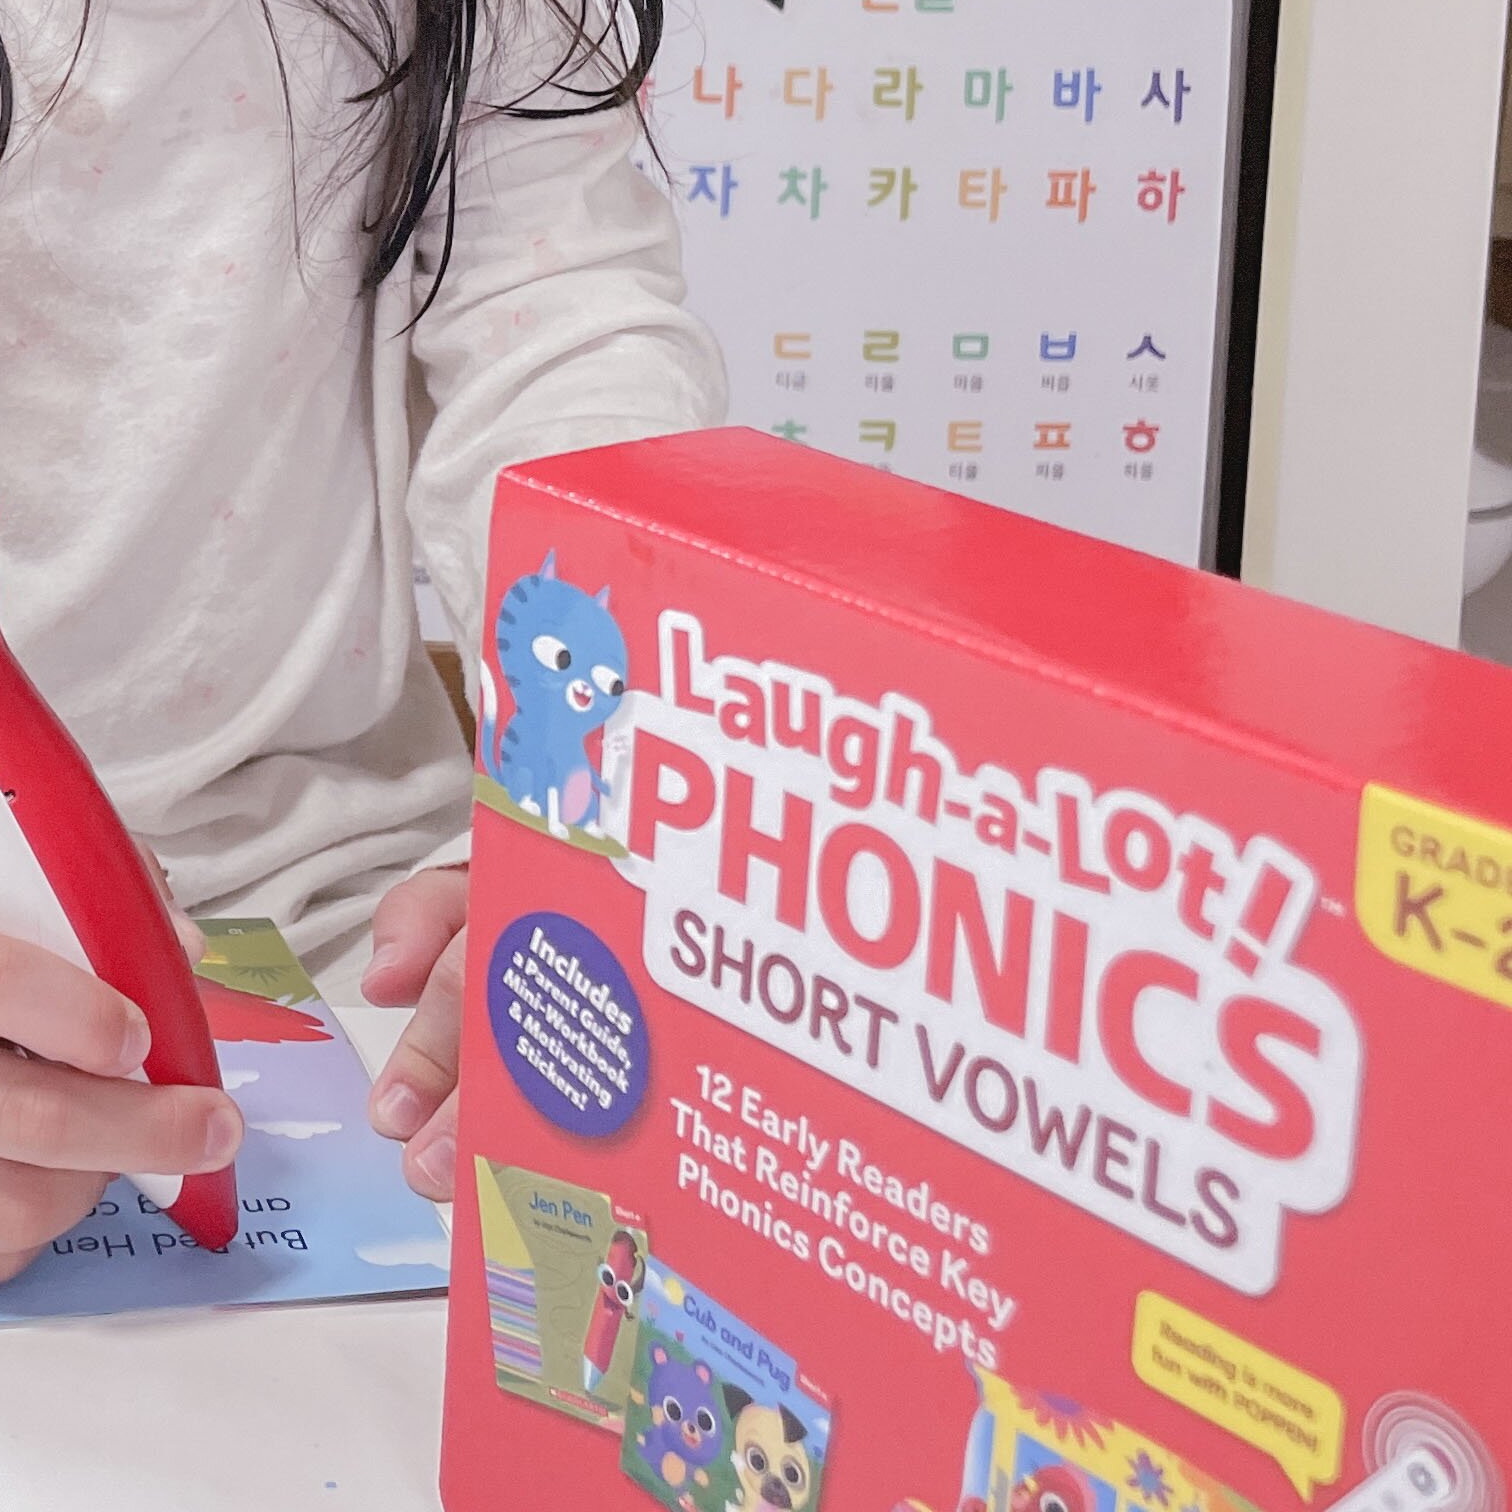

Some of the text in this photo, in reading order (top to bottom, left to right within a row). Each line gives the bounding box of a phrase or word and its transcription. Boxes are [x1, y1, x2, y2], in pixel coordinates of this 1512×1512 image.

[693, 66, 743, 120] 나
[784, 66, 833, 121] 다
[872, 66, 924, 122] 라
[964, 67, 1014, 123] 마
[1052, 66, 1103, 123] 바
[1141, 67, 1192, 123] 사
[689, 164, 1186, 225] 자 차 카 타 파 하
[774, 330, 1166, 362] ㄷ ㄹ ㅁ ㅂ ㅅ
[858, 420, 896, 452] ㅋ
[948, 421, 982, 453] ㅌ
[1033, 422, 1071, 449] ㅍ
[1122, 417, 1160, 453] ㅎ
[670, 627, 1295, 978] Laugh-a-Lot!
[529, 926, 632, 1035] Includes
[628, 727, 1322, 1161] PHONICS
[502, 968, 630, 1094] Mini-Workbook
[508, 1001, 613, 1110] & Motivating
[512, 951, 632, 1070] a Parent Guide,
[516, 1036, 588, 1111] Stickers!
[670, 909, 1240, 1248] SHORT VOWELS
[529, 1191, 593, 1228] Jen Pen
[670, 1097, 1016, 1331] That Reinforce Key
[695, 1064, 991, 1255] 12 Early Readers
[52, 1233, 136, 1258] Hen
[244, 1228, 308, 1251] But
[678, 1153, 812, 1261] Phonics
[818, 1237, 998, 1370] Concepts
[683, 1295, 717, 1333] Cub
[721, 1327, 754, 1360] and
[757, 1349, 791, 1392] Pug
